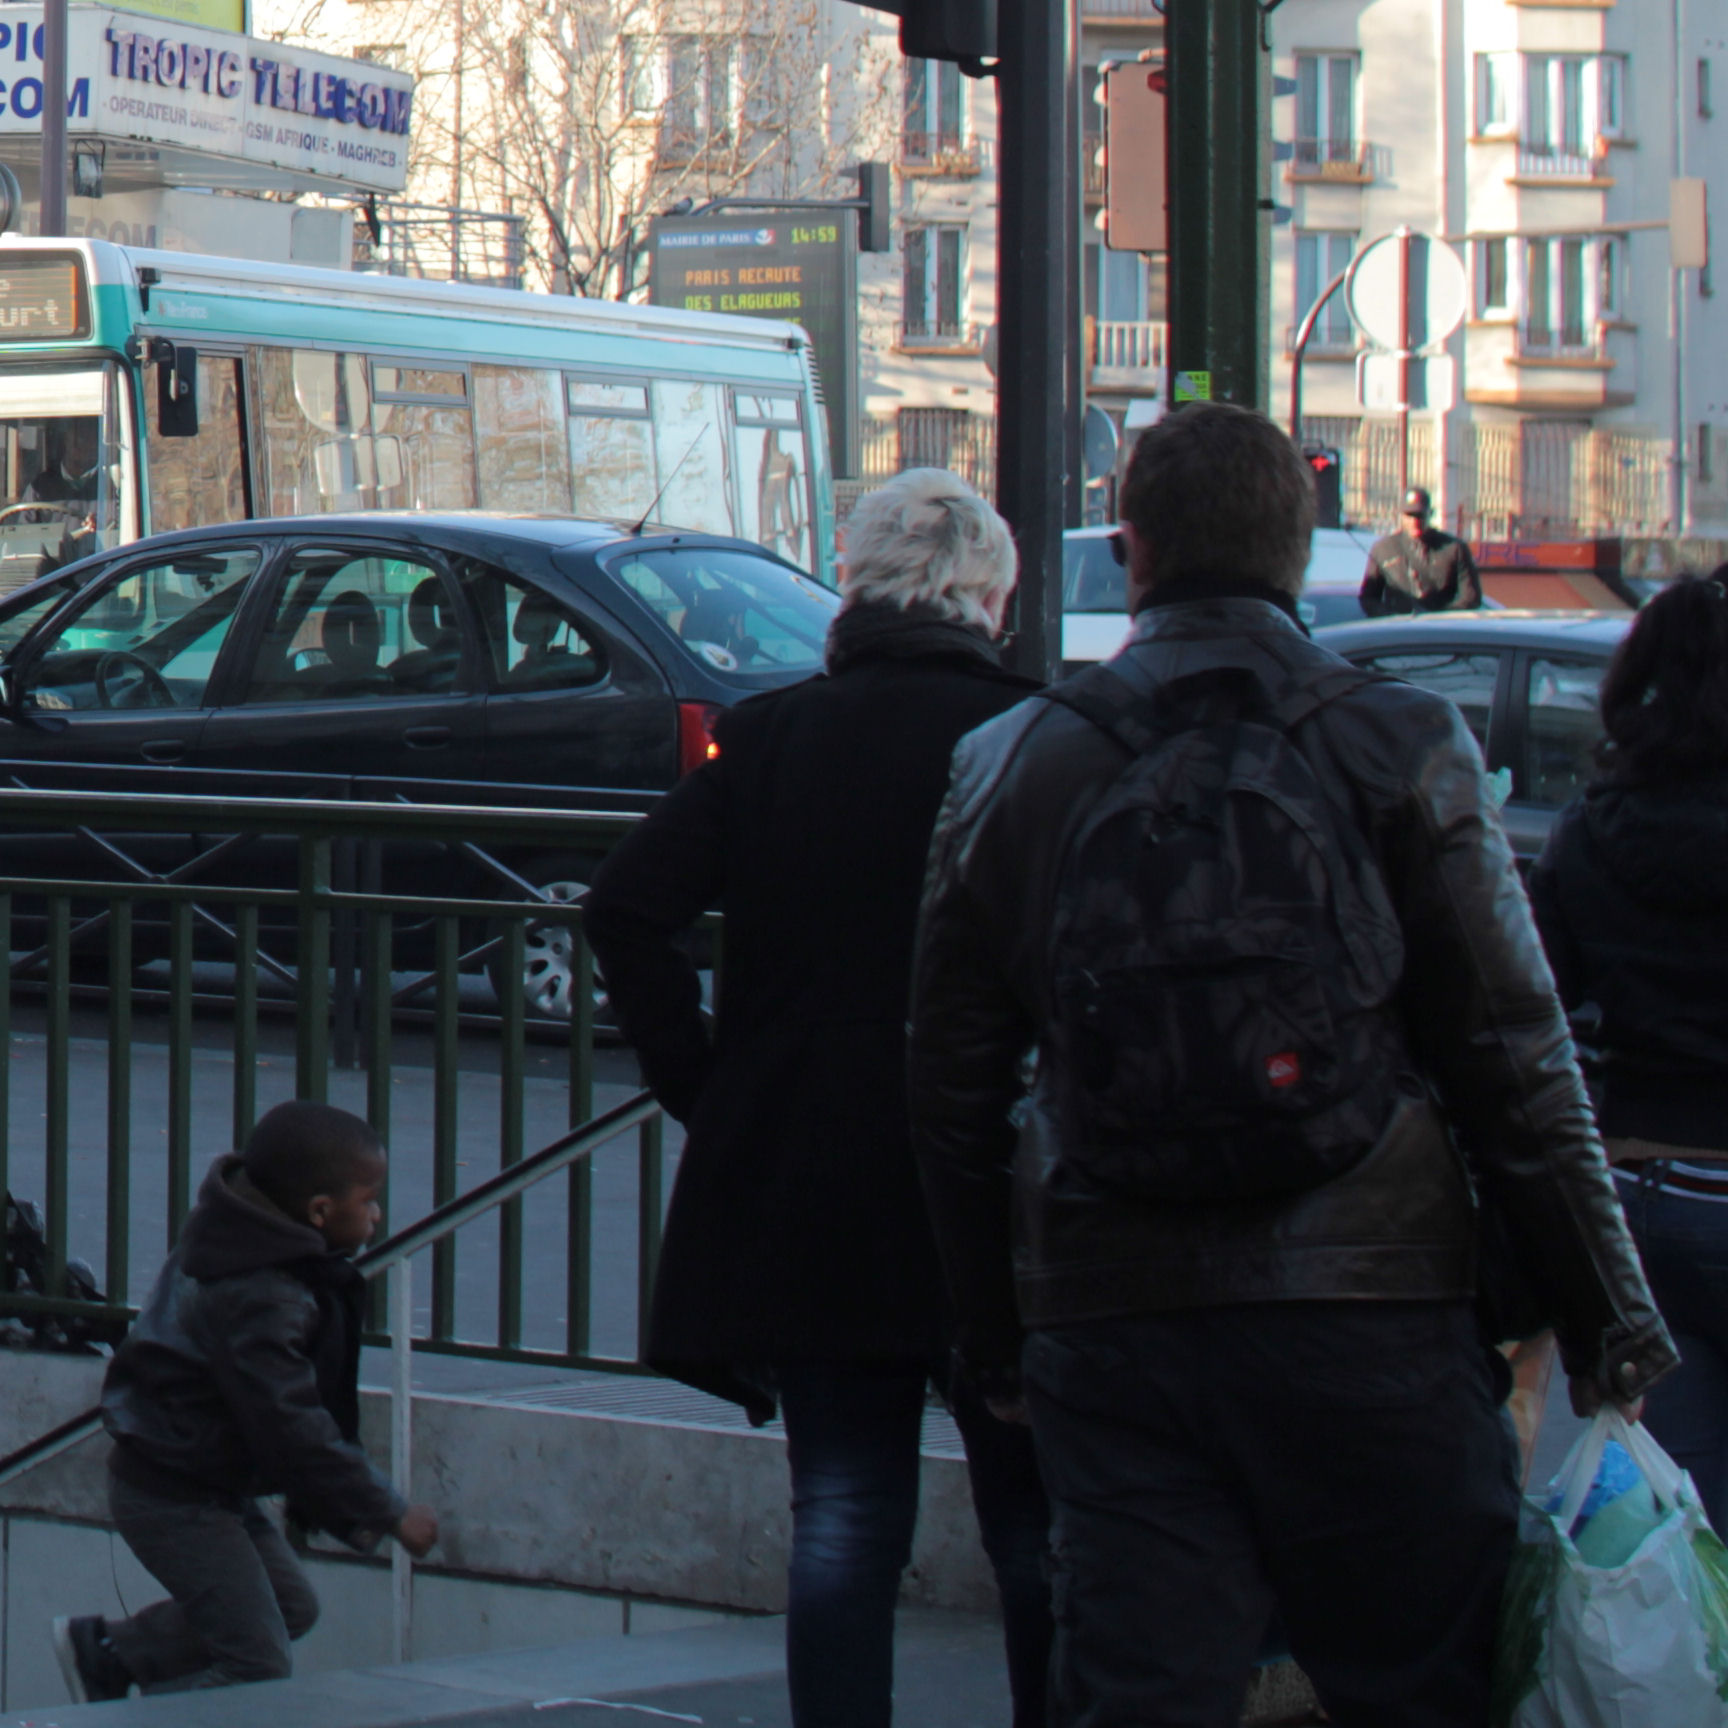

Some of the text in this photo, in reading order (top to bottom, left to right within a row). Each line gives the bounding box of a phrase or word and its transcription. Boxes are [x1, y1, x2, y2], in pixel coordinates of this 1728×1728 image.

[106, 28, 243, 99] TROPIC
[250, 57, 412, 135] TELECOM
[109, 96, 187, 125] OPERATEUR
[659, 231, 751, 247] MAIRIE DE PARIS
[685, 266, 802, 286] PARIS RECRUTE
[685, 292, 801, 310] DES ELAGUEURS
